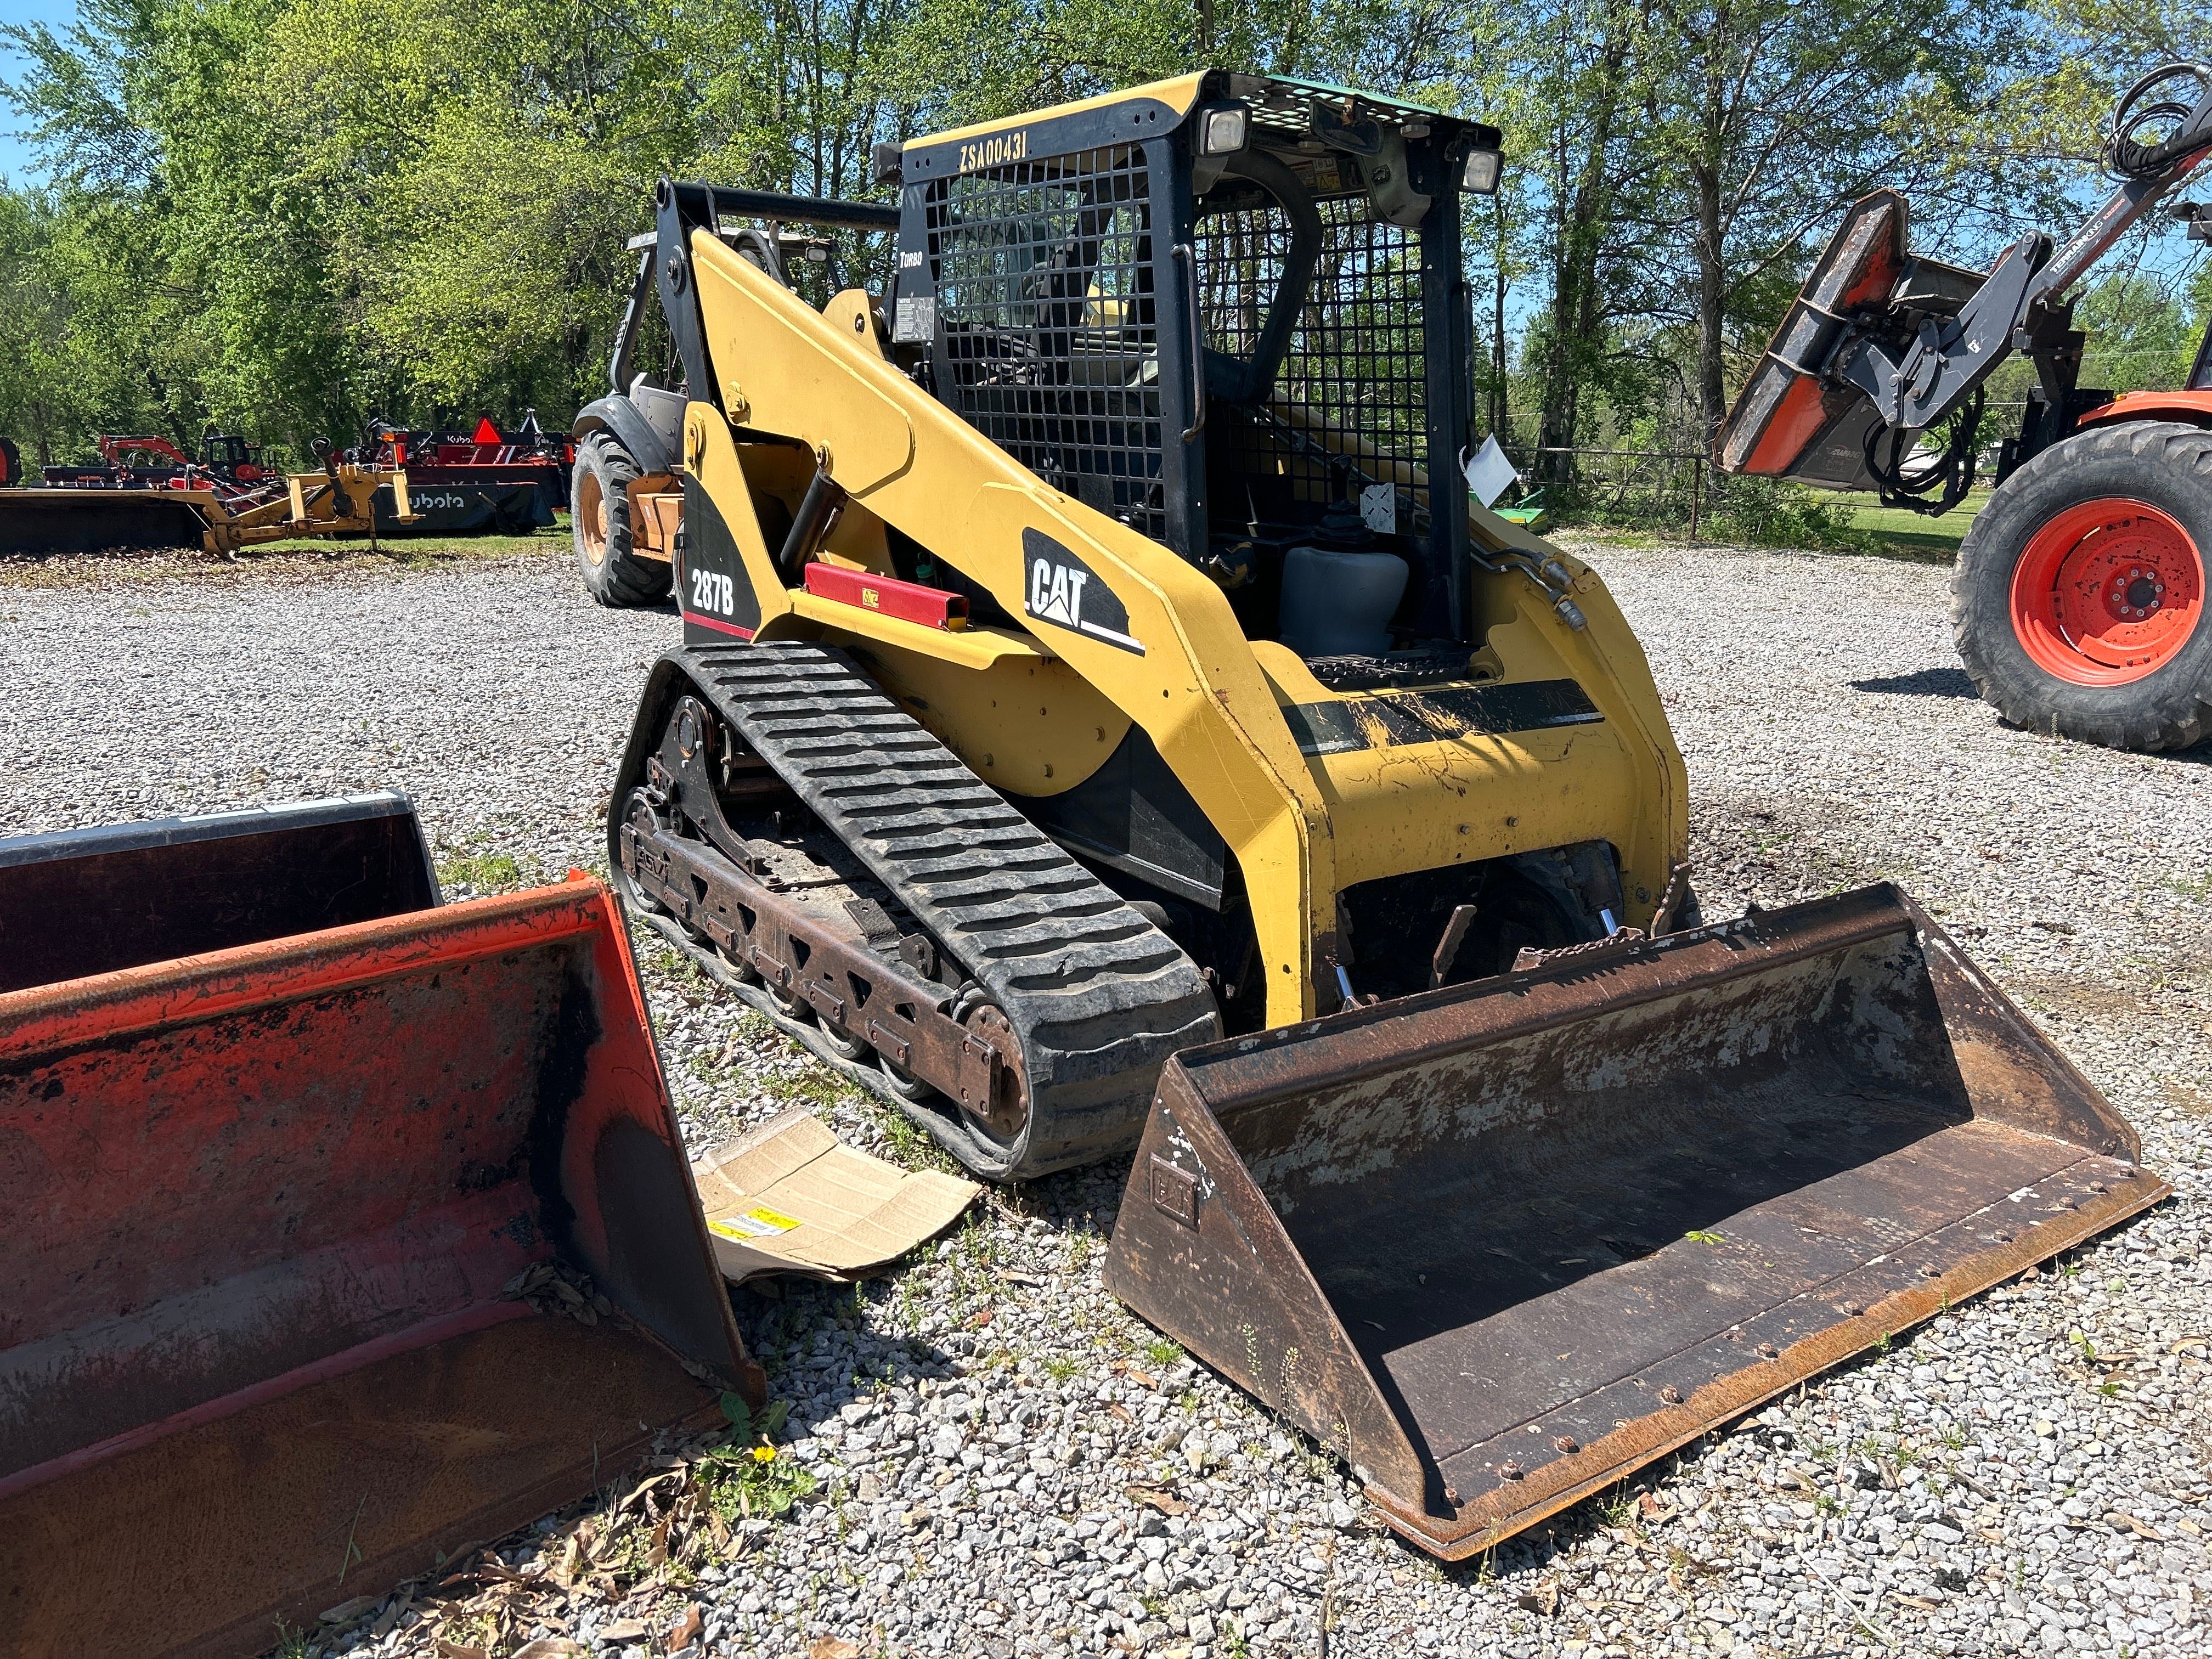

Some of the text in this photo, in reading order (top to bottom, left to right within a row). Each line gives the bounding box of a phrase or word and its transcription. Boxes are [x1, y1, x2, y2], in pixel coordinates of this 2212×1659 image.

[447, 435, 473, 443] Kubo
[408, 493, 464, 509] ubota
[692, 568, 734, 616] 287B
[1031, 558, 1087, 628] CAT
